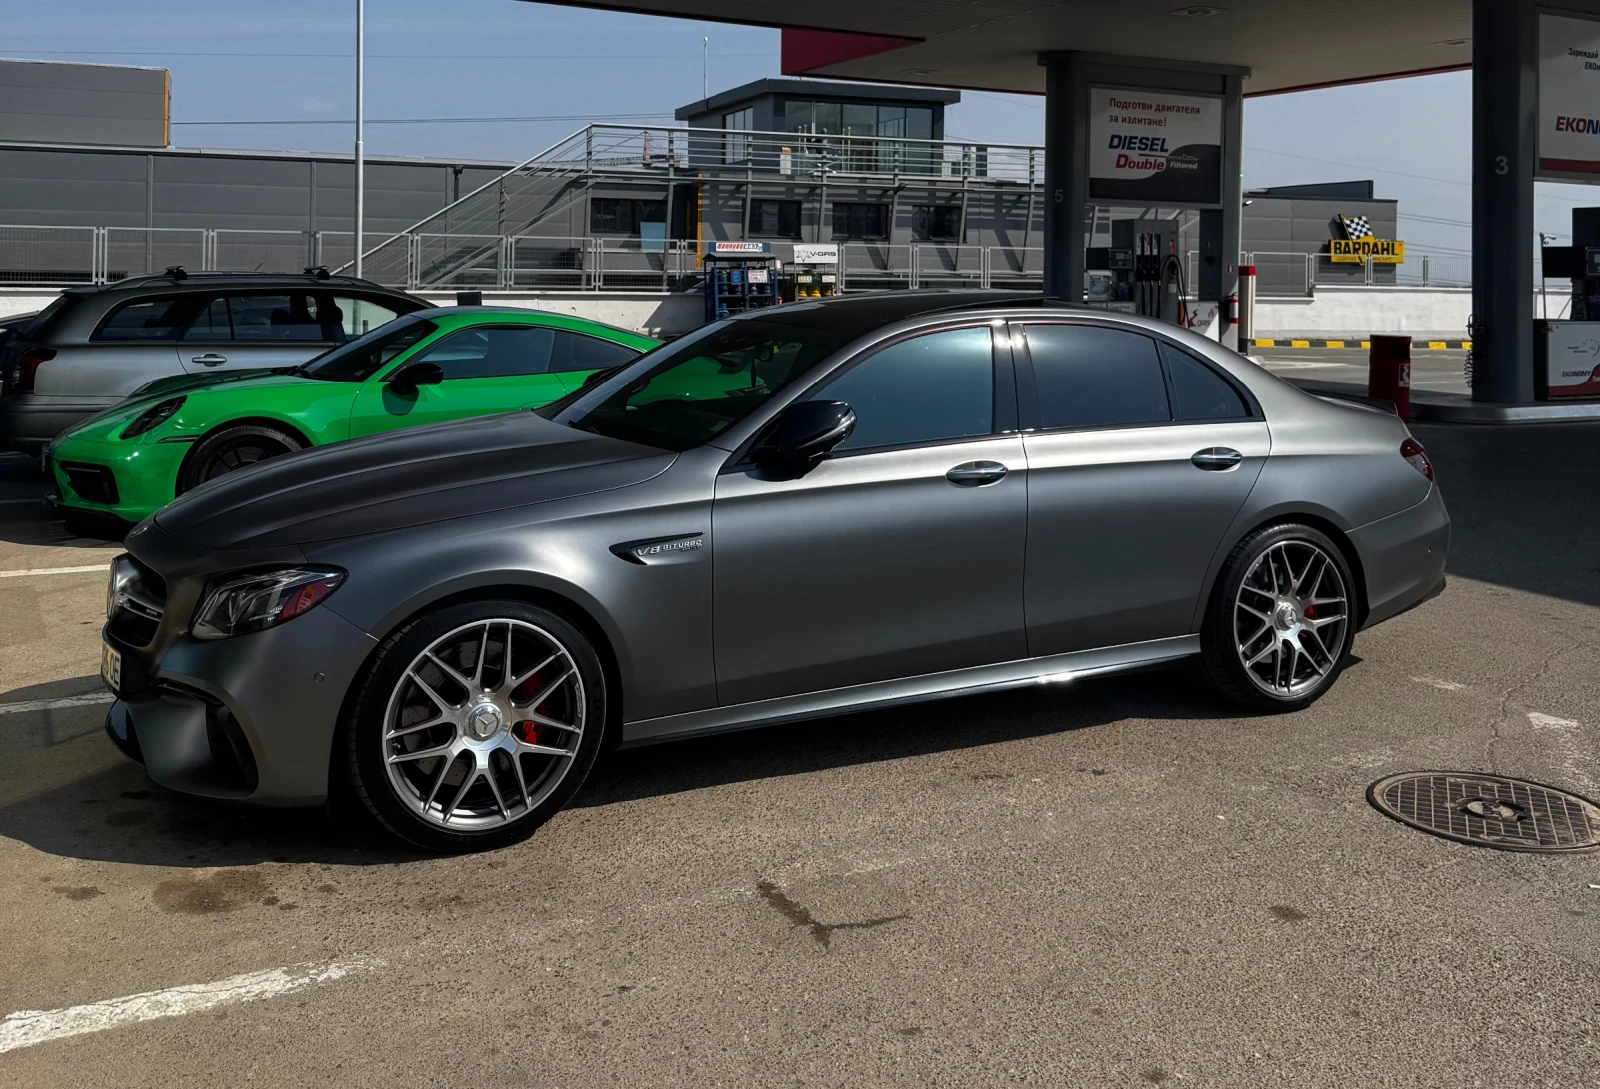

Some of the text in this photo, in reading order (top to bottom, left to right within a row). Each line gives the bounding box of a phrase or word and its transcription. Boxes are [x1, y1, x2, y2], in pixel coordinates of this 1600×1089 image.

[1109, 98, 1200, 115] Подготви двигателя
[1108, 115, 1166, 127] за излитане!
[1108, 134, 1169, 153] DIESEL
[1115, 154, 1165, 171] Double
[1169, 161, 1198, 170] Filtered
[1495, 156, 1509, 175] 3
[1054, 190, 1064, 203] 5
[1333, 241, 1399, 256] BARDAHL
[1562, 370, 1592, 378] EKONOMY
[637, 545, 660, 556] V8
